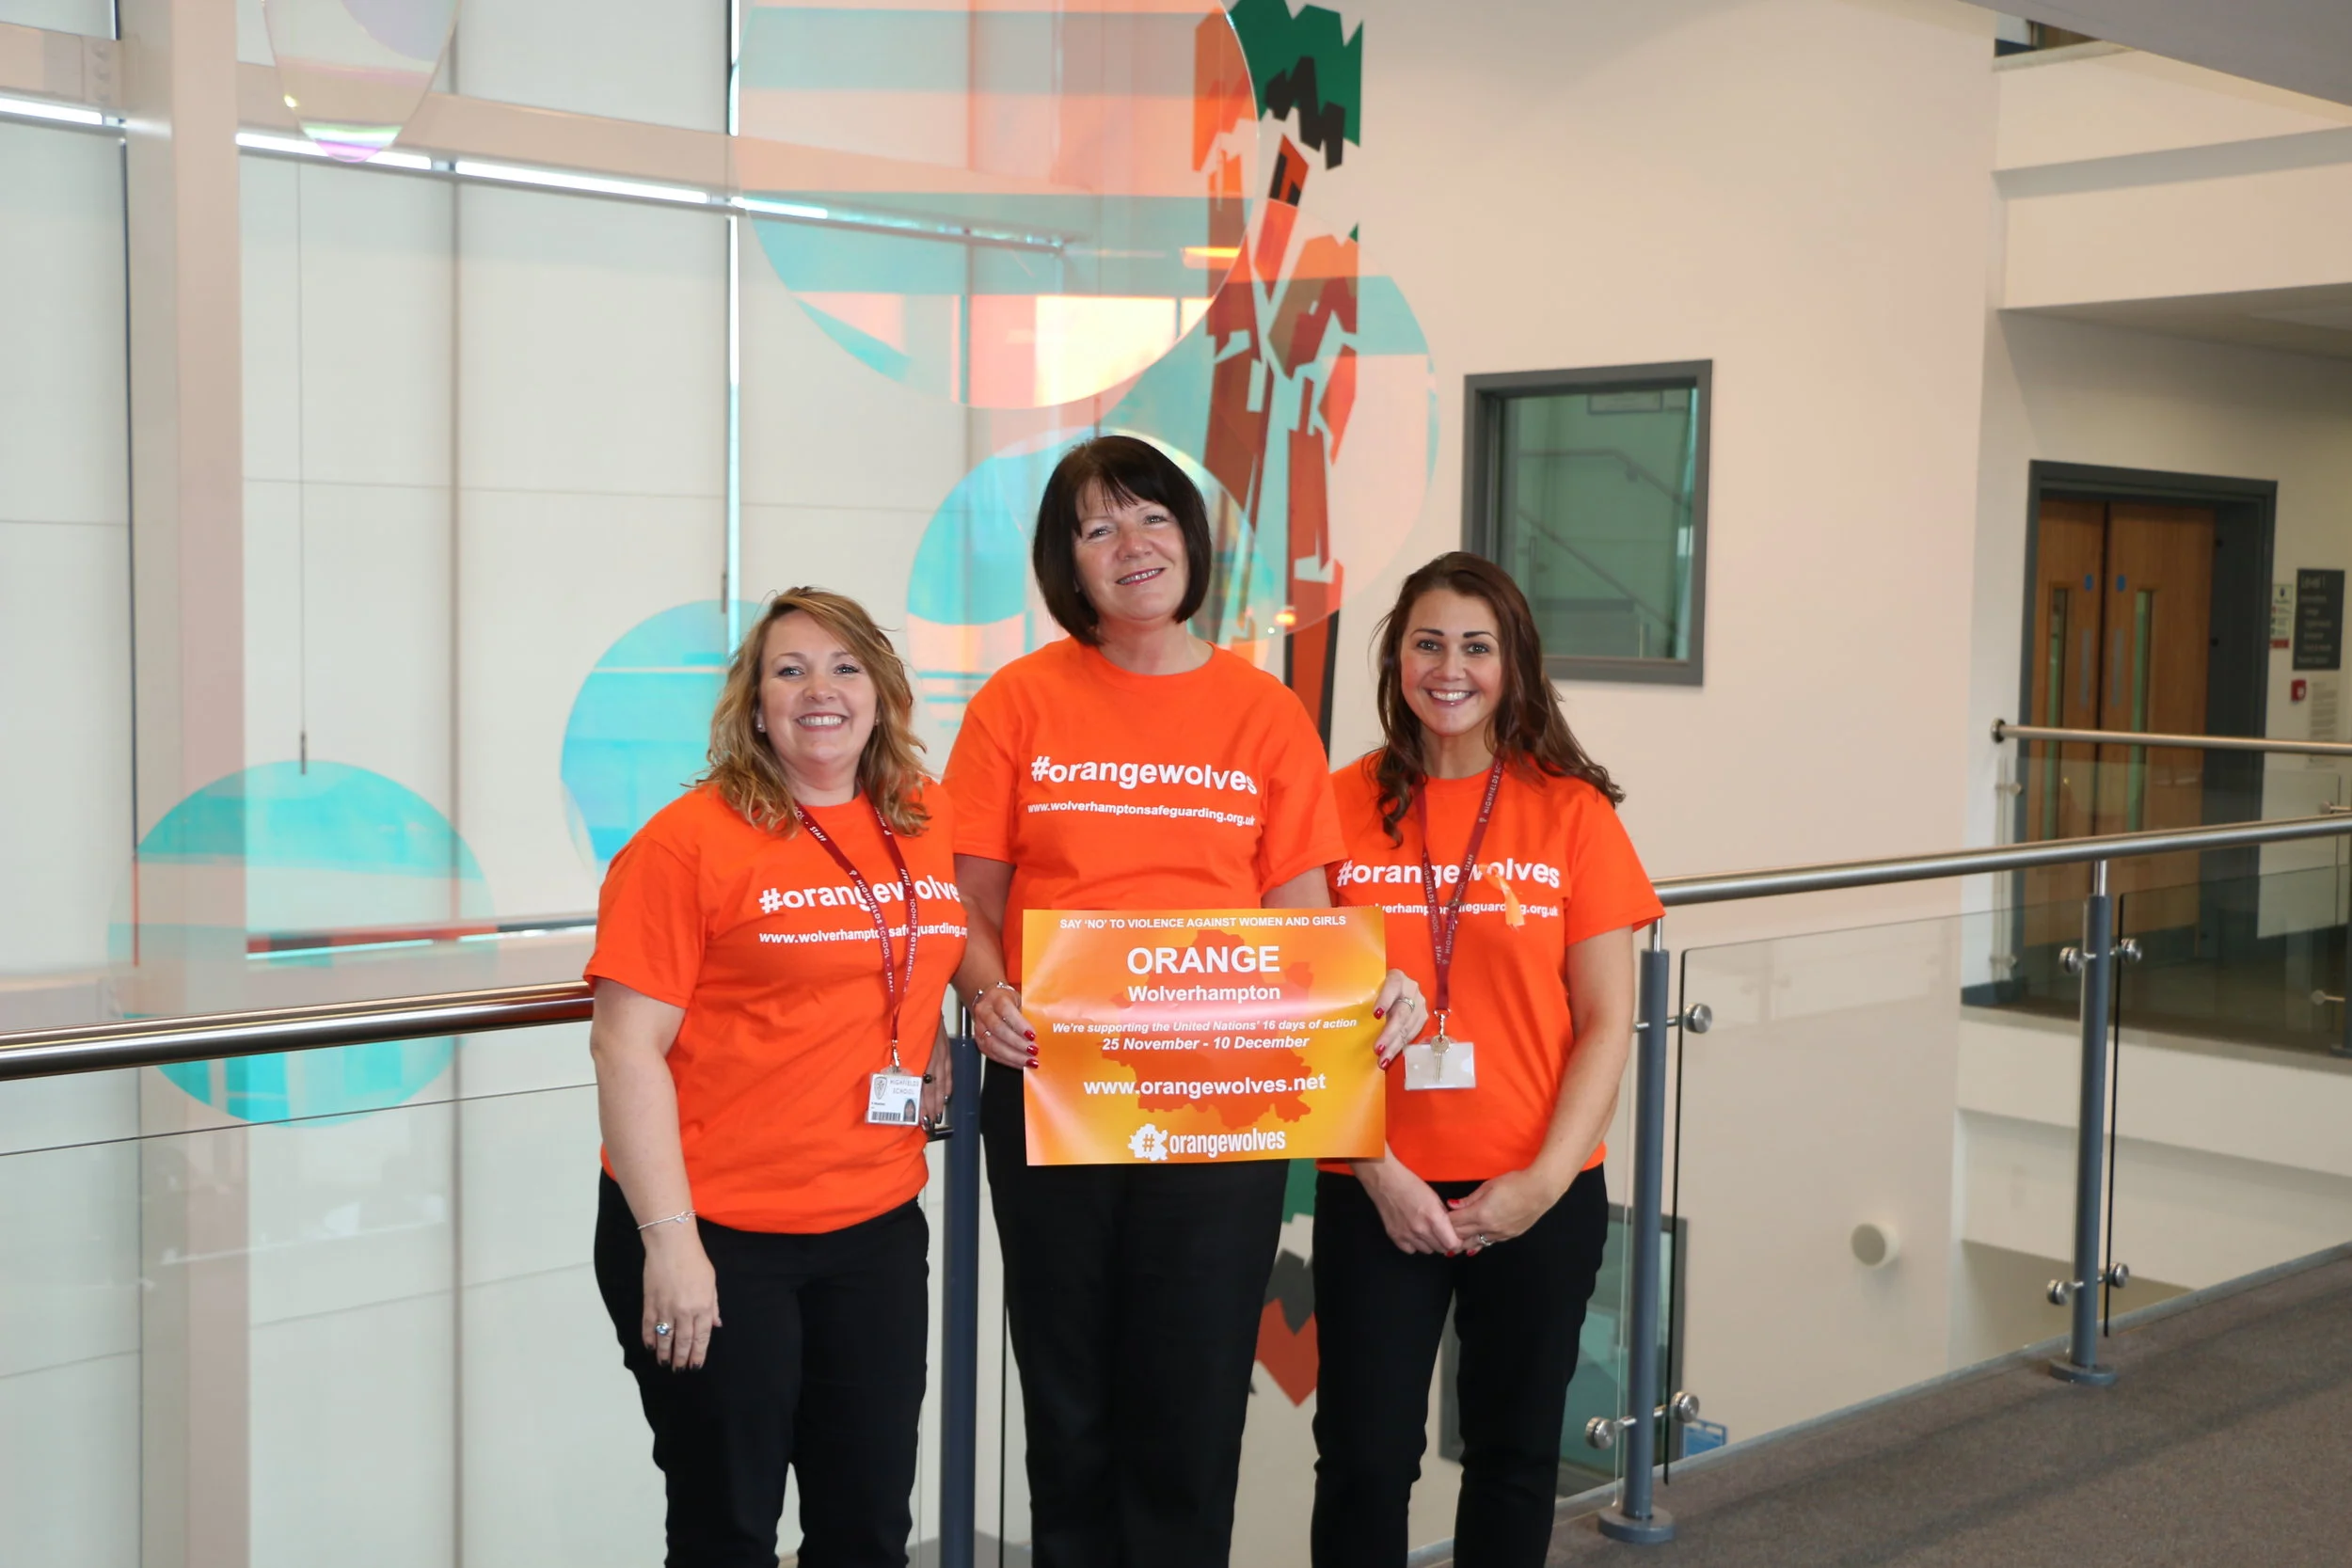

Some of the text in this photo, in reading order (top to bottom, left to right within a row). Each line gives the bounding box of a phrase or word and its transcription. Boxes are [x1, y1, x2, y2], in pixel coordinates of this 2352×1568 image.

[1030, 755, 1258, 795] #orangewolves
[1027, 800, 1256, 827] www.wolverhamptonsafeguarding.org.uk
[810, 826, 828, 842] STAFF
[1059, 915, 1347, 929] SAY 'NO' TO VIOLENCE AGAINST WOMEN AND GIRLS
[1127, 945, 1280, 975] ORANGE
[1128, 985, 1280, 1005] Wolverhampton
[1053, 1019, 1358, 1035] We're supporting the United Nations' 16 days of action
[1103, 1037, 1120, 1051] 25
[1123, 1037, 1200, 1051] November
[1214, 1037, 1231, 1050] 10
[1234, 1036, 1311, 1050] December
[1083, 1073, 1327, 1100] www.orangewolves.net
